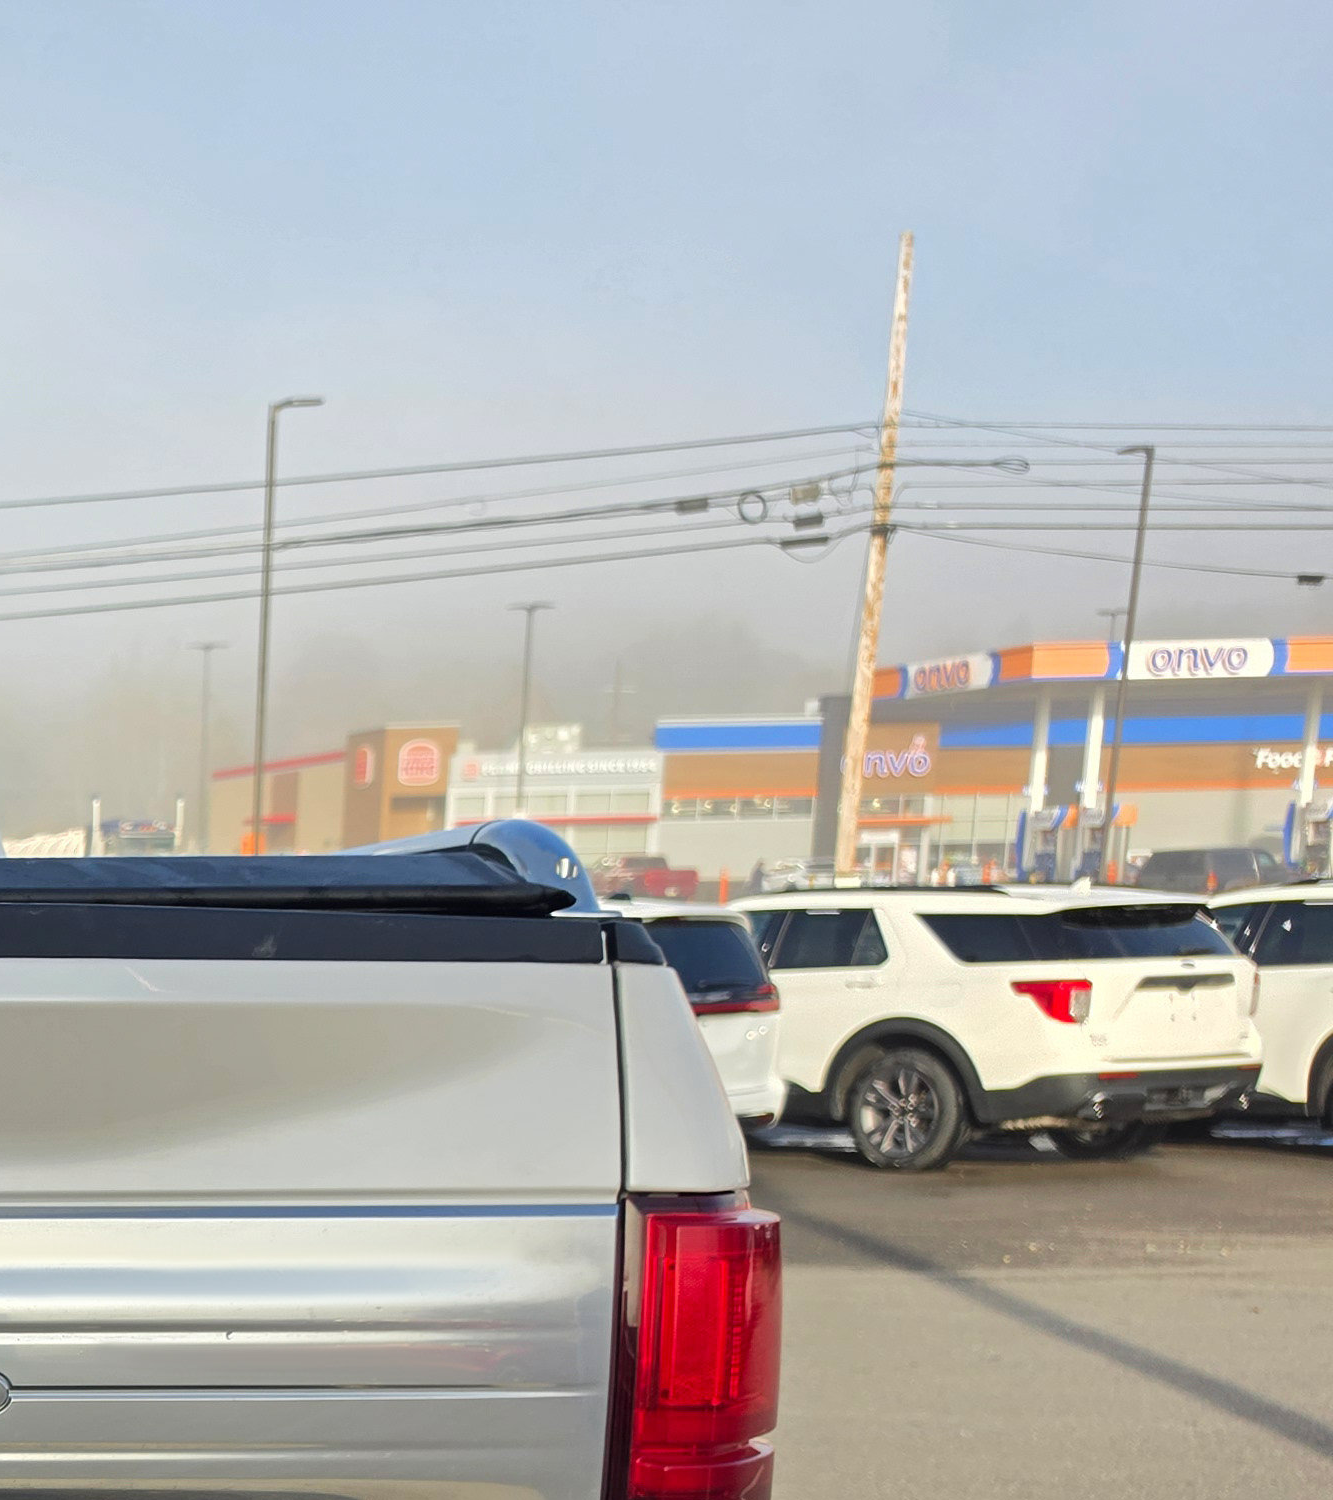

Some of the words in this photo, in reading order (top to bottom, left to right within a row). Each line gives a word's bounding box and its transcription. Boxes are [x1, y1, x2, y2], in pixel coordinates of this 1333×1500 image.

[913, 659, 970, 693] onvo
[1145, 646, 1248, 677] onvo
[840, 748, 932, 778] nvo
